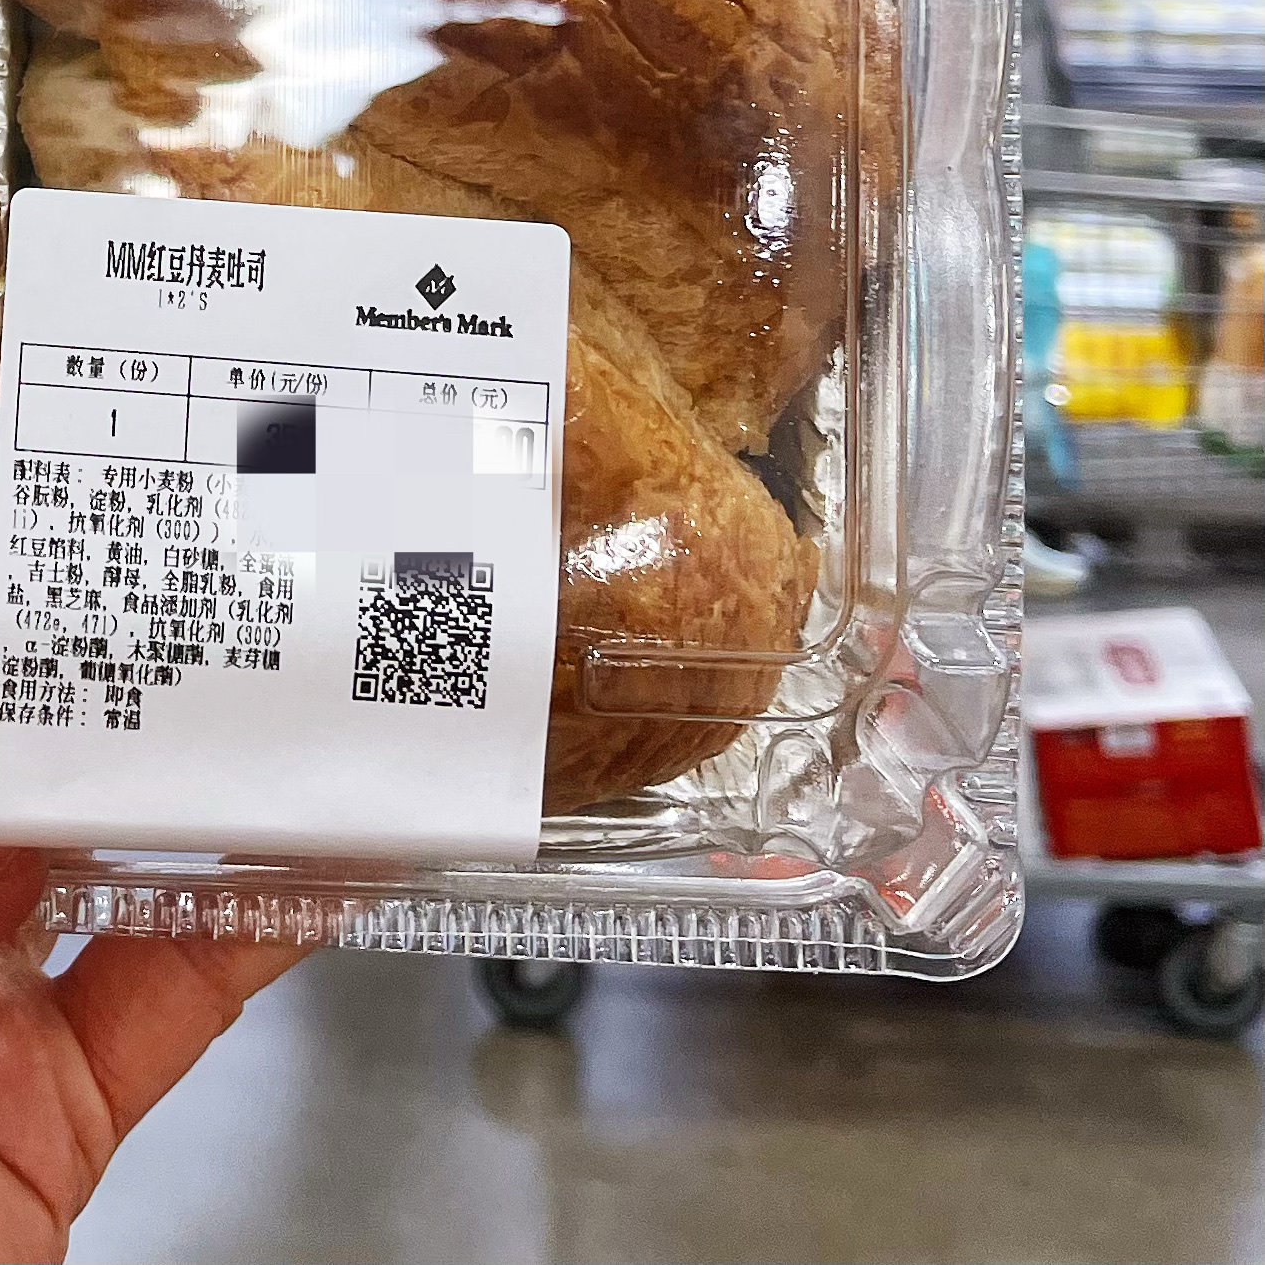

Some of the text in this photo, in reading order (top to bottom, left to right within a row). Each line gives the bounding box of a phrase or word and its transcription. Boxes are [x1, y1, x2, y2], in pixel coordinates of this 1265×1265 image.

[105, 240, 266, 291] MM红豆丹麦吐司
[355, 305, 514, 339] Member's Mark
[66, 354, 159, 383] 数量（份）
